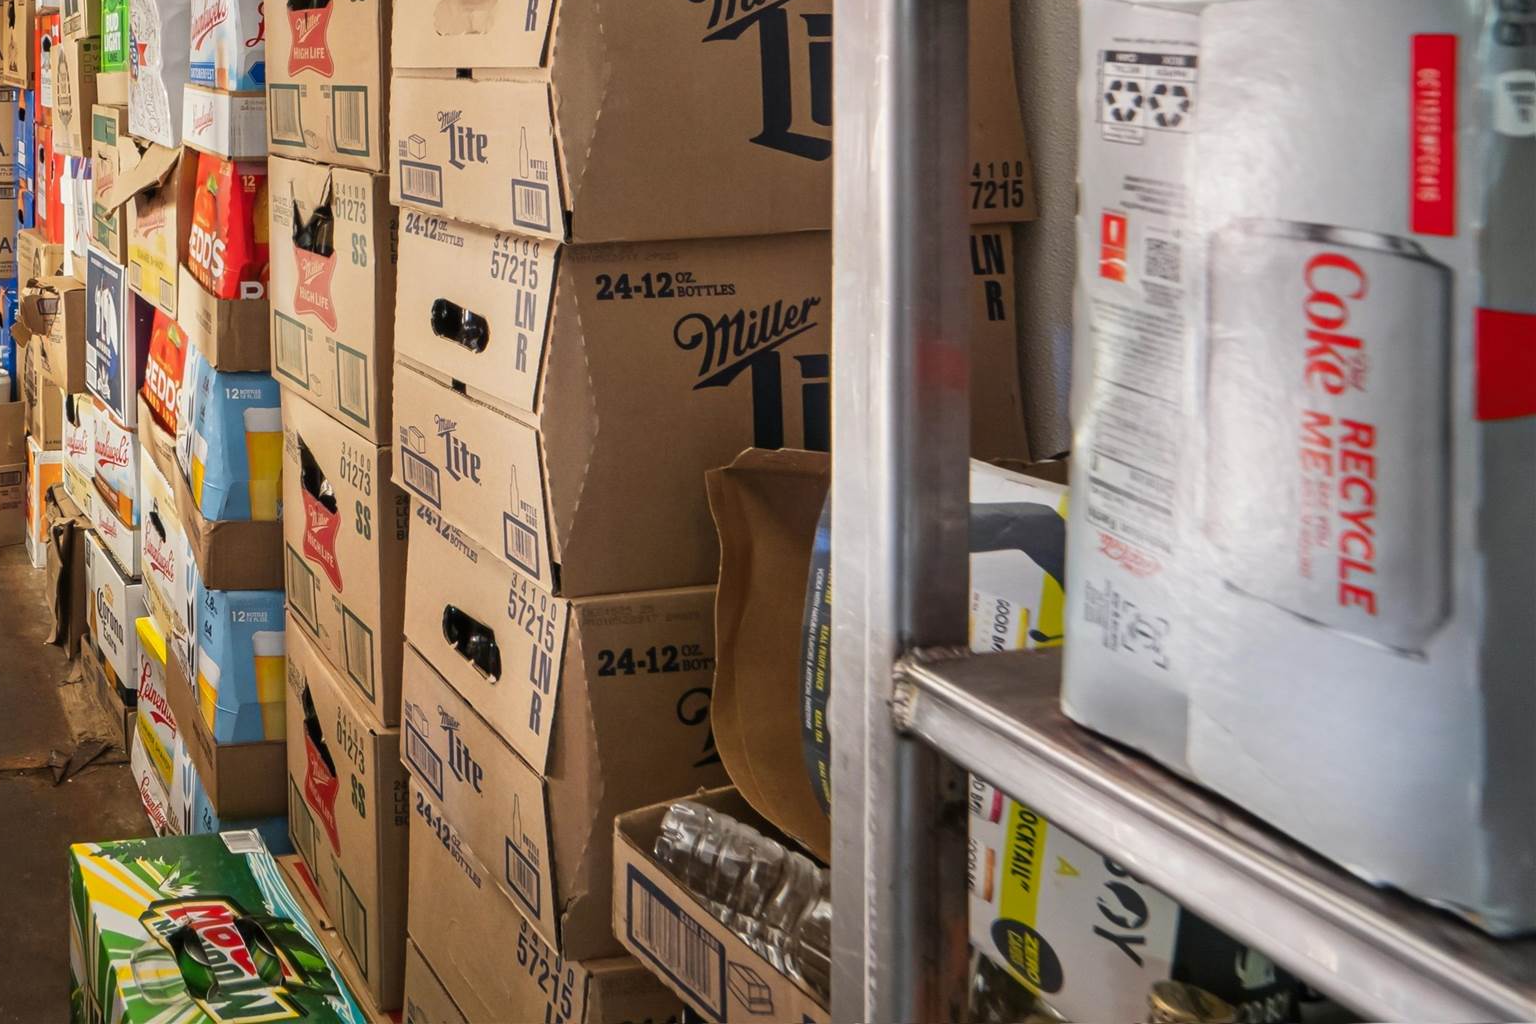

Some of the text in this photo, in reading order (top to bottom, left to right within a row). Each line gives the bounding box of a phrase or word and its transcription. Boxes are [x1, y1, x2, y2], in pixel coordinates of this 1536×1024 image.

[295, 14, 322, 44] Miller
[294, 46, 326, 60] HIGH LIFE
[437, 110, 463, 132] Miller
[440, 122, 488, 170] Lite
[242, 175, 256, 187] 12
[335, 197, 366, 225] 01273
[405, 212, 440, 239] 24-12
[351, 232, 368, 268] SS
[437, 230, 464, 249] BOTTLES
[972, 234, 1004, 276] LN
[490, 251, 539, 290] 57215
[595, 272, 698, 301] 24-12 OZ.
[677, 282, 736, 298] BOTTLES
[299, 287, 330, 311] HIGH LIFE
[515, 289, 538, 332] LN
[987, 279, 1006, 321] R
[674, 295, 822, 376] Miller
[1303, 252, 1369, 397] Coke
[515, 332, 528, 373] R
[225, 387, 239, 400] 12
[434, 413, 458, 433] Miller
[1300, 409, 1333, 478] ME
[339, 458, 372, 497] 01273
[437, 428, 481, 486] Lite
[354, 499, 372, 542] SS
[1337, 417, 1378, 617] RECYCLE
[320, 545, 335, 568] LIFE
[449, 532, 479, 564] BOTTLES
[96, 586, 125, 645] Corona
[232, 611, 246, 623] 12
[507, 588, 556, 654] 57215
[992, 597, 1012, 633] GOOD
[530, 644, 552, 696] LN
[598, 644, 703, 678] 24-12 OZ.
[437, 704, 462, 728] Miller
[528, 690, 542, 736] R
[336, 720, 366, 776] 01273
[439, 721, 484, 798] Lite
[350, 772, 367, 819] SS
[416, 791, 452, 849] 24-12
[450, 844, 482, 890] BOTTLES
[516, 932, 574, 1020] 57215
[1020, 931, 1042, 982] ZERO
